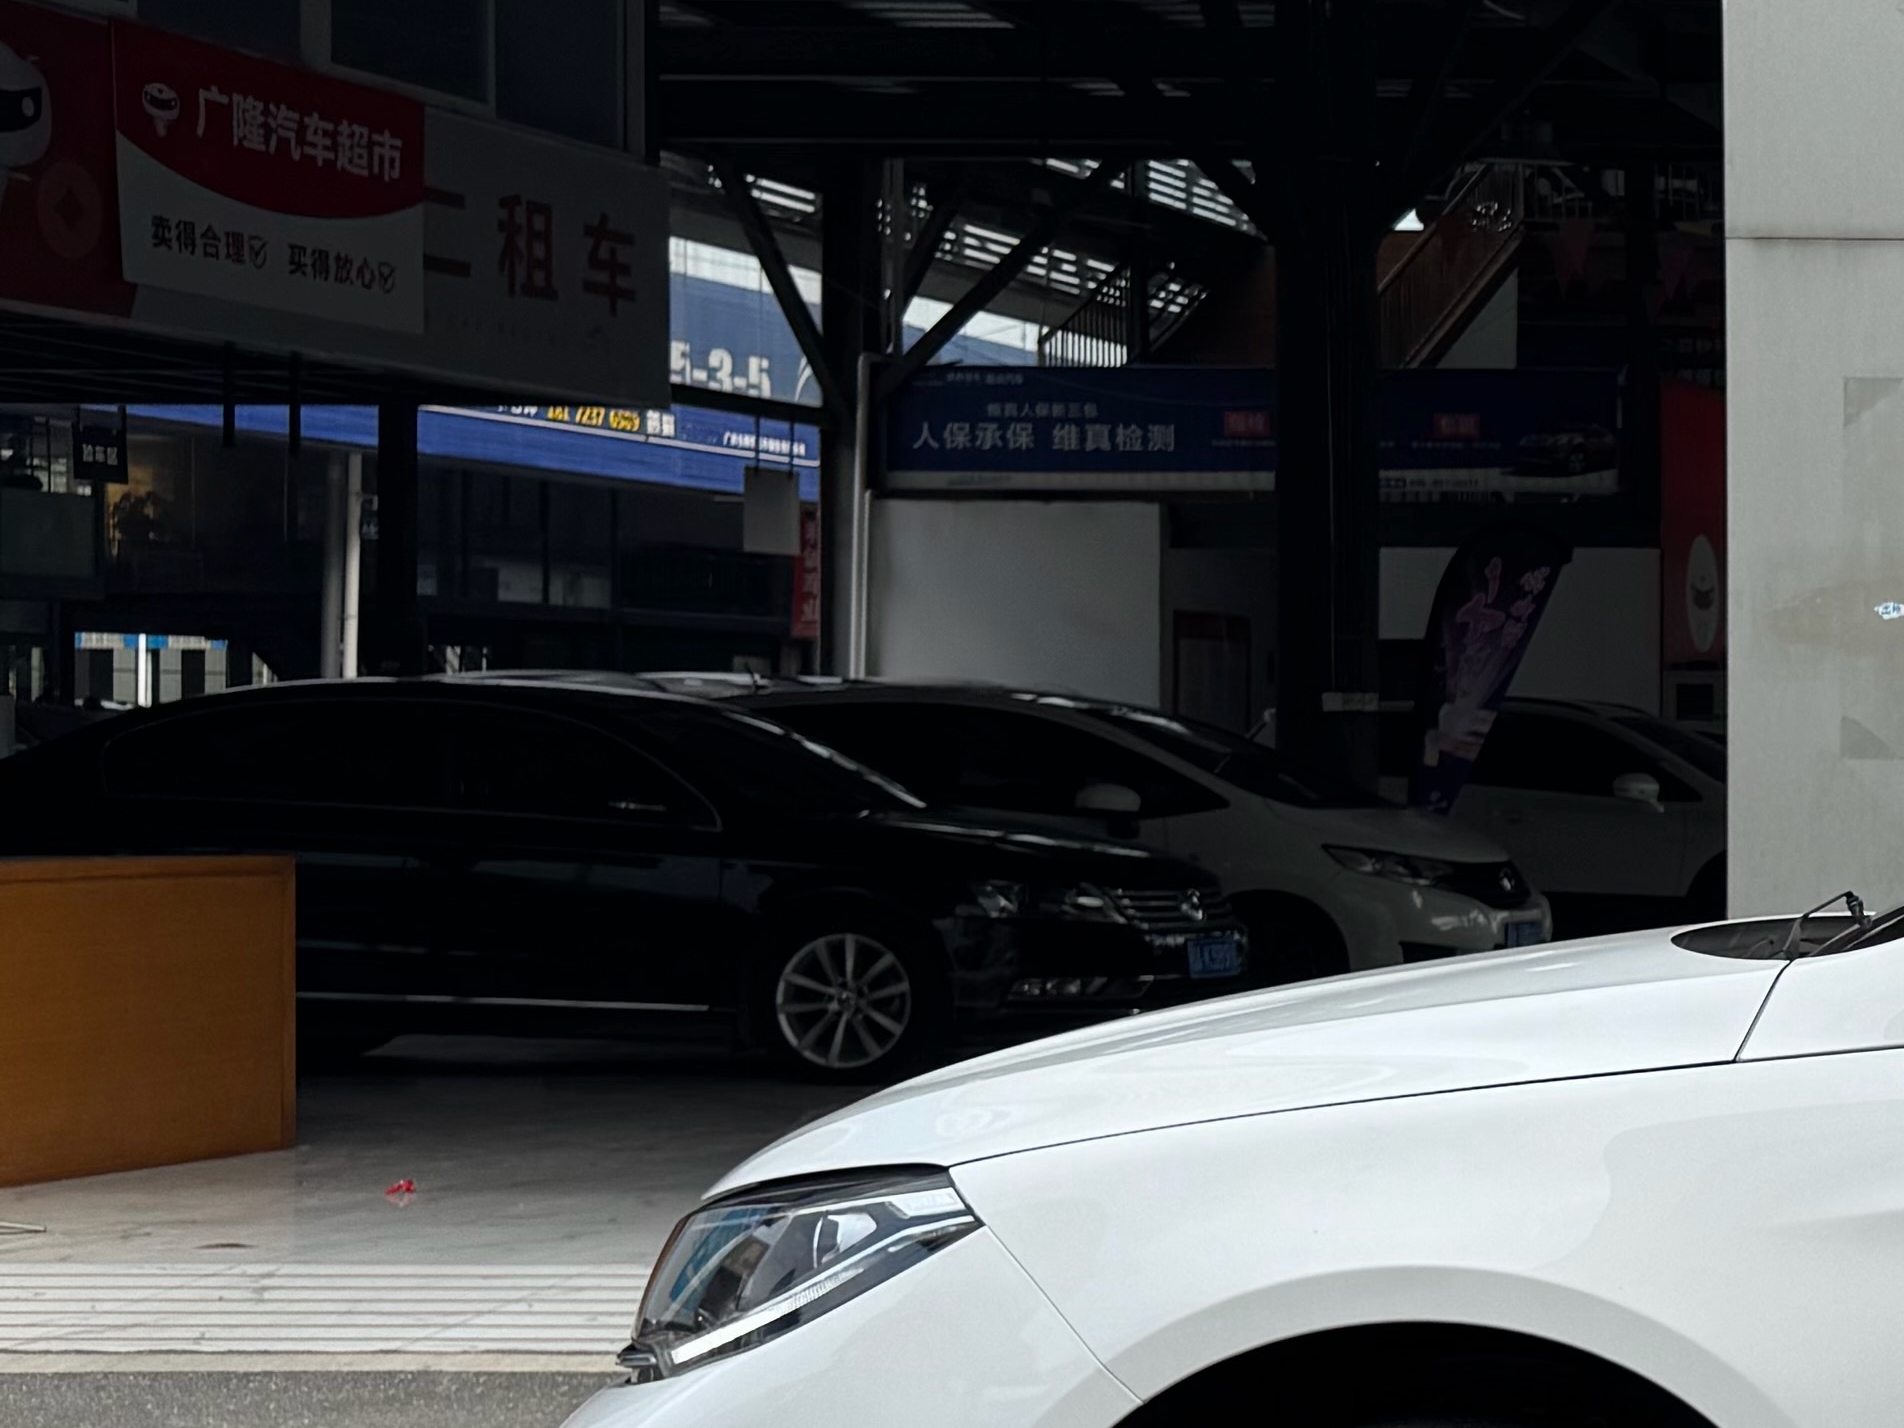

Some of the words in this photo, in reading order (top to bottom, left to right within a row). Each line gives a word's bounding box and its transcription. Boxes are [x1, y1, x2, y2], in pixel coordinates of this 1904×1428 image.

[196, 85, 402, 183] 广隆汽车超市
[151, 216, 245, 264] 卖得合理
[287, 243, 376, 290] 买得放心
[912, 421, 1035, 451] 人保承保
[1052, 423, 1176, 452] 维真检测
